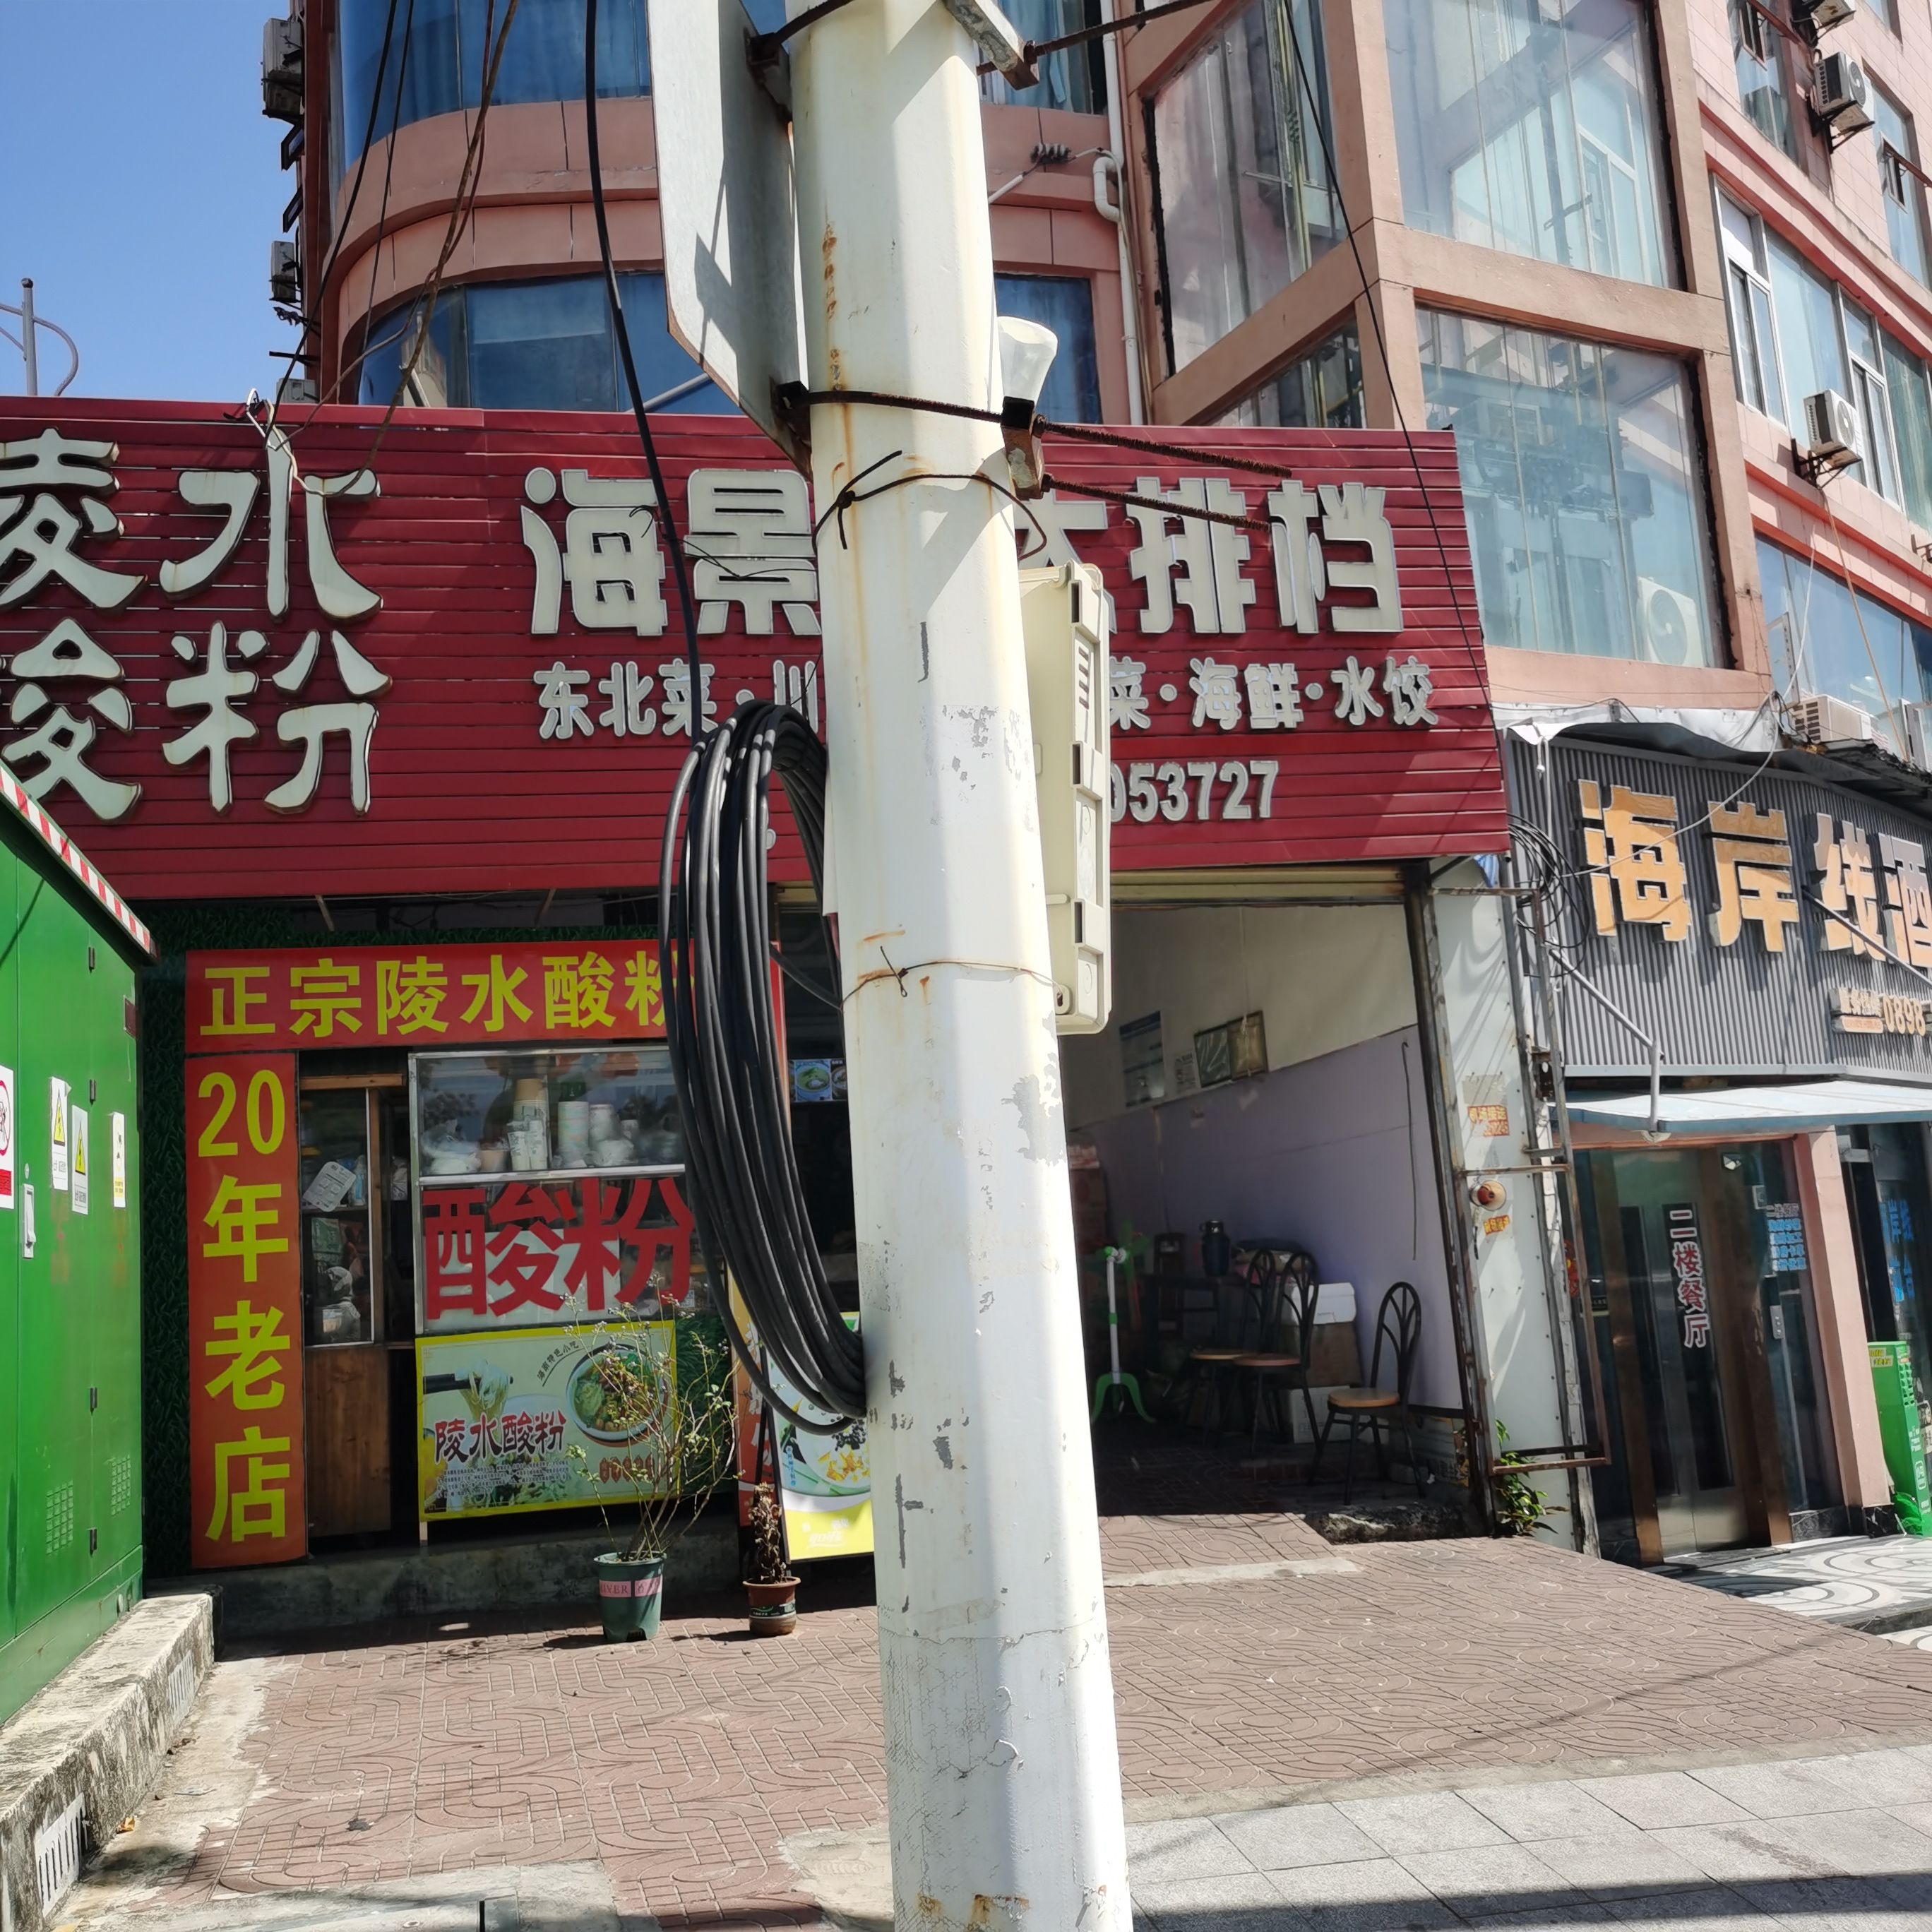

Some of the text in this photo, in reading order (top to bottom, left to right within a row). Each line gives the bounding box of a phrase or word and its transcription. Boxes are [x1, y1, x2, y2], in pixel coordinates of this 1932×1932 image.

[198, 1069, 291, 1544] 20年老店
[424, 1177, 695, 1320] 酸粉
[1669, 1210, 1710, 1349] 二楼餐厅
[434, 1410, 567, 1464] 陵水酸粉
